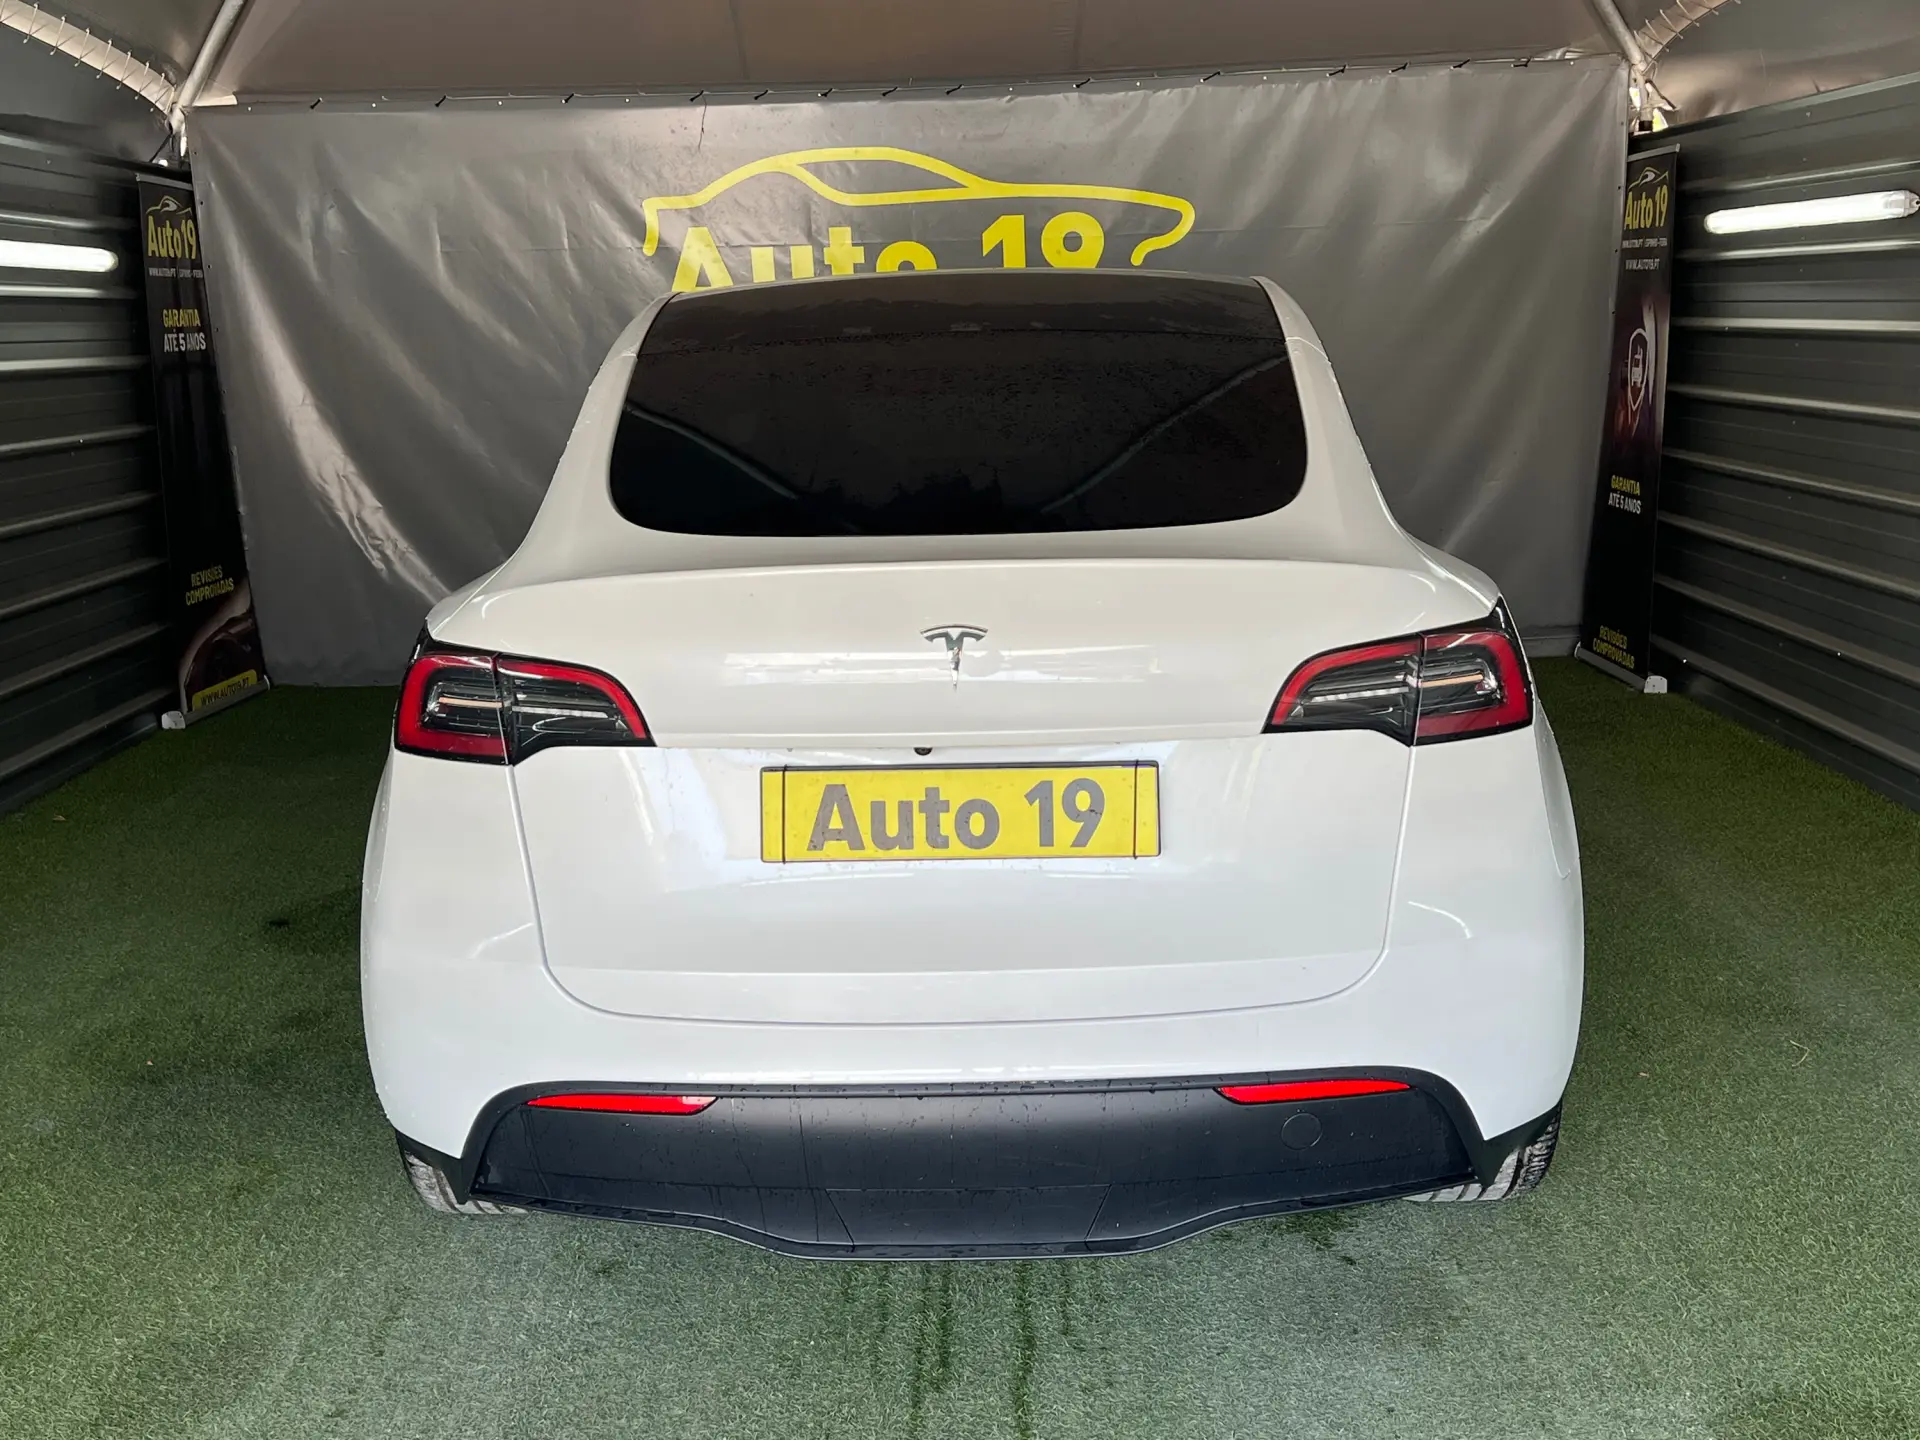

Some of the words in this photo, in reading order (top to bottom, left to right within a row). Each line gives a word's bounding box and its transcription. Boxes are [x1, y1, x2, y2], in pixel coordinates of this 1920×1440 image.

[1624, 191, 1653, 230] Auto
[1654, 184, 1668, 227] 19
[147, 215, 181, 259] Auto
[181, 219, 197, 259] 19
[981, 211, 1105, 268] 19
[162, 308, 201, 328] GARANTIA
[163, 328, 178, 353] ATÉ
[178, 332, 186, 352] 5
[186, 332, 207, 352] ANOS
[1610, 474, 1641, 496] GARANTIA
[1608, 490, 1620, 508] ATÉ
[1624, 496, 1642, 515] ANOS
[806, 783, 1000, 851] Auto
[1023, 777, 1106, 848] 19
